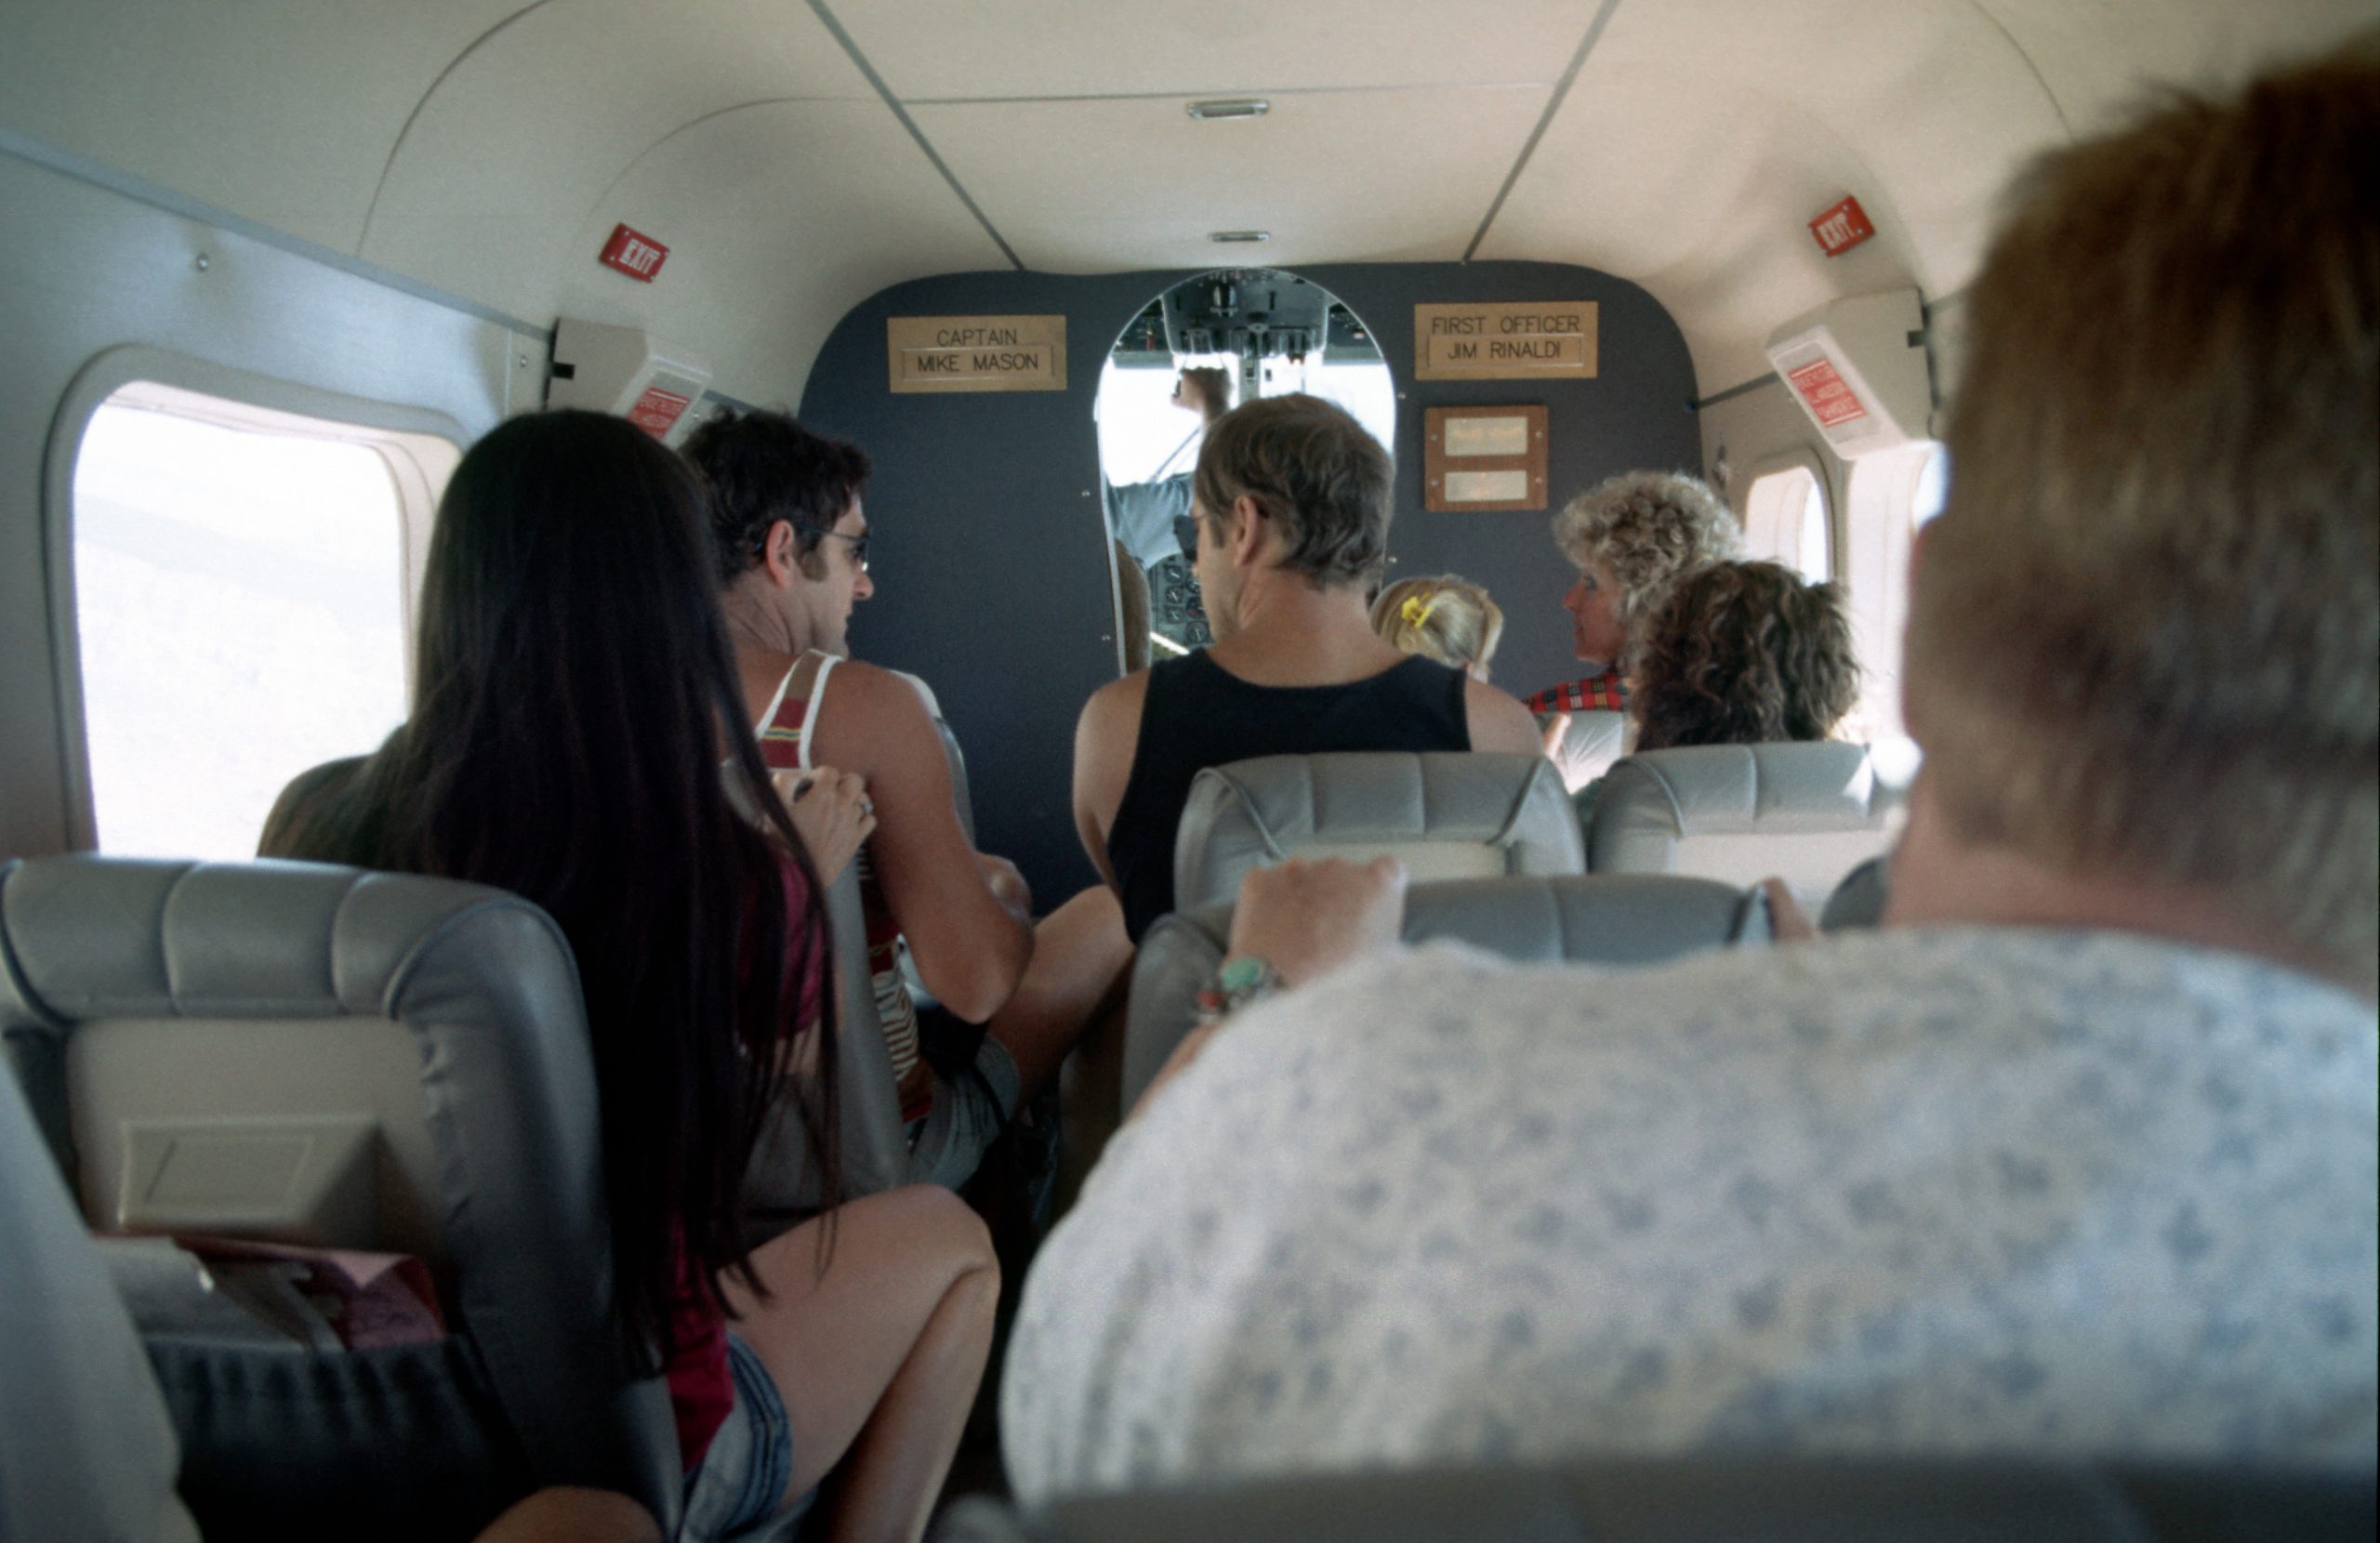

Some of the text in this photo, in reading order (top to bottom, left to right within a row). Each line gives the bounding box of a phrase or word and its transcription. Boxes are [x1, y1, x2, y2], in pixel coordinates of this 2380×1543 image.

[1817, 212, 1856, 249] EXIT
[619, 238, 661, 275] EXIT
[1432, 315, 1580, 335] FIRST OFFICER
[937, 329, 1017, 347] CAPTAIN
[1448, 341, 1560, 359] JIM RINALDI
[918, 353, 1038, 372] MIKE MASON
